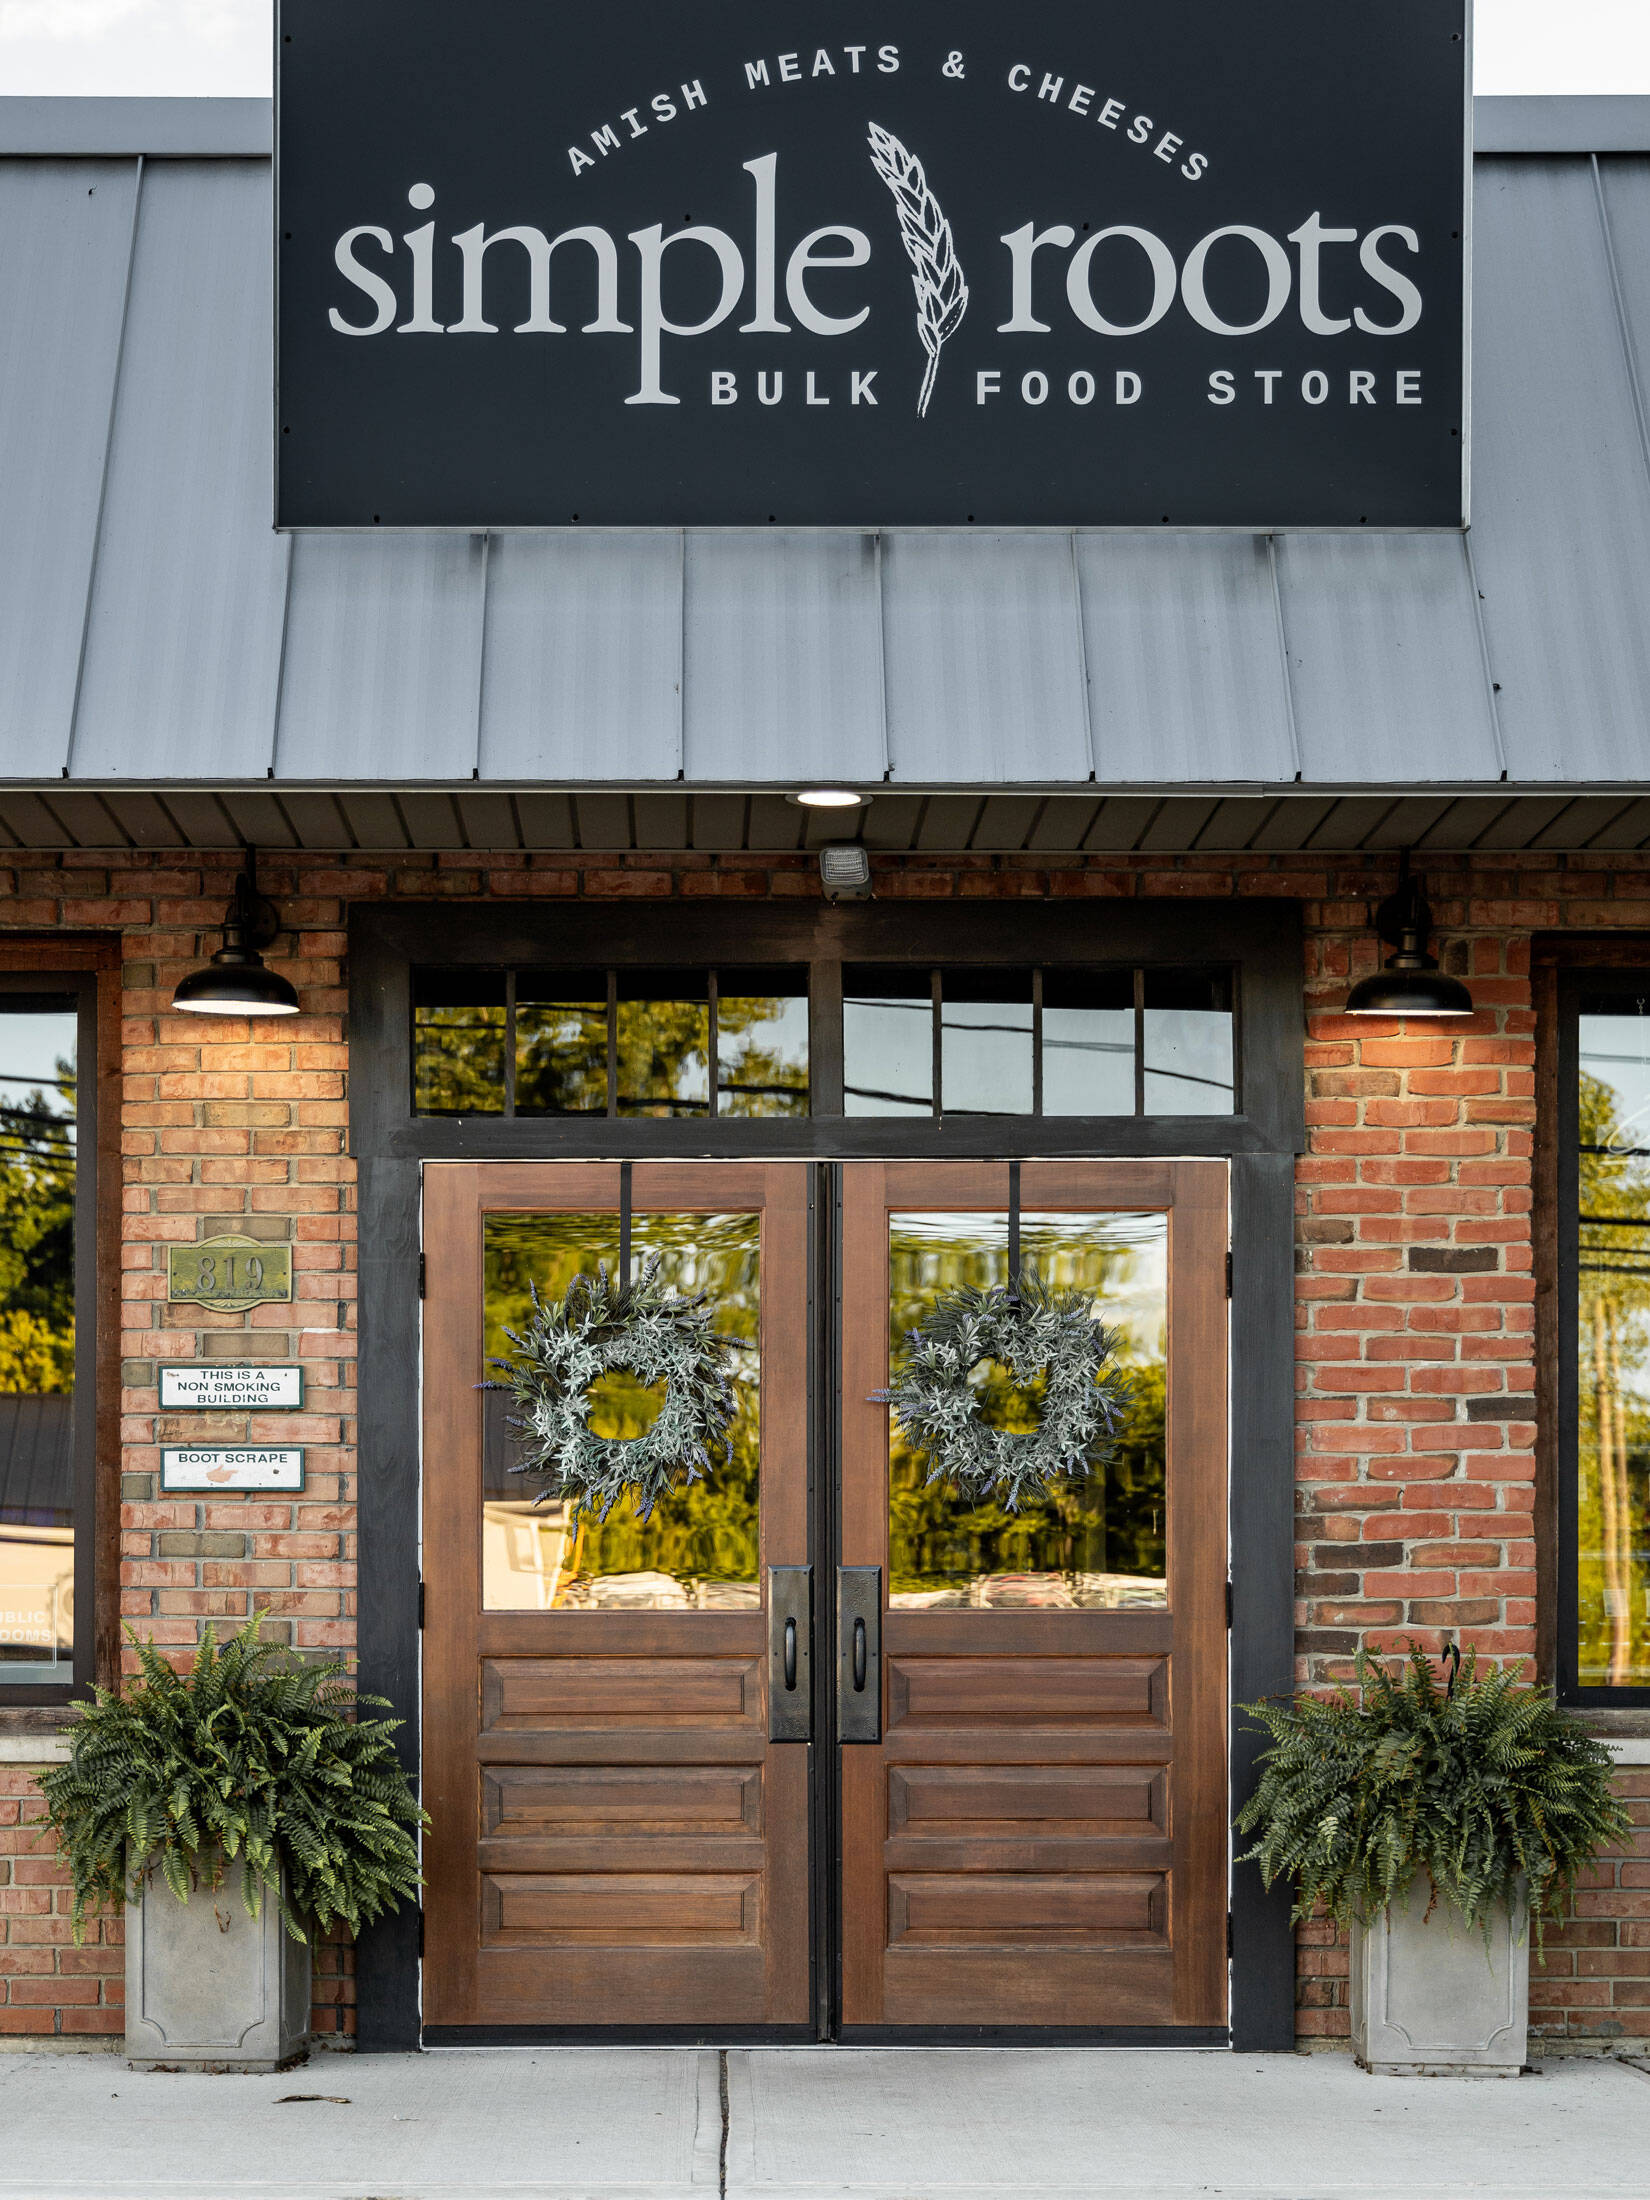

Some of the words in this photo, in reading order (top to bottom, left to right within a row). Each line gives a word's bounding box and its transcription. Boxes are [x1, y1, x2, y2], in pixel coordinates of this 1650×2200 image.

[567, 79, 708, 177] AMISH
[744, 45, 900, 90] MEATS
[941, 50, 965, 80] &
[1006, 64, 1209, 181] CHEESES
[328, 151, 871, 405] simple
[996, 210, 1423, 336] roots
[711, 371, 879, 406] BULK
[976, 370, 1142, 406] FOOD
[1207, 370, 1422, 405] STORE
[196, 1256, 264, 1291] 819
[200, 1370, 233, 1380] THIS
[237, 1370, 251, 1380] IS
[255, 1370, 265, 1380] A
[177, 1382, 210, 1392] NON
[214, 1382, 281, 1392] SMOKING
[197, 1394, 269, 1404] BUILDING
[178, 1453, 220, 1463] BOOT
[224, 1453, 288, 1464] SCRAPE
